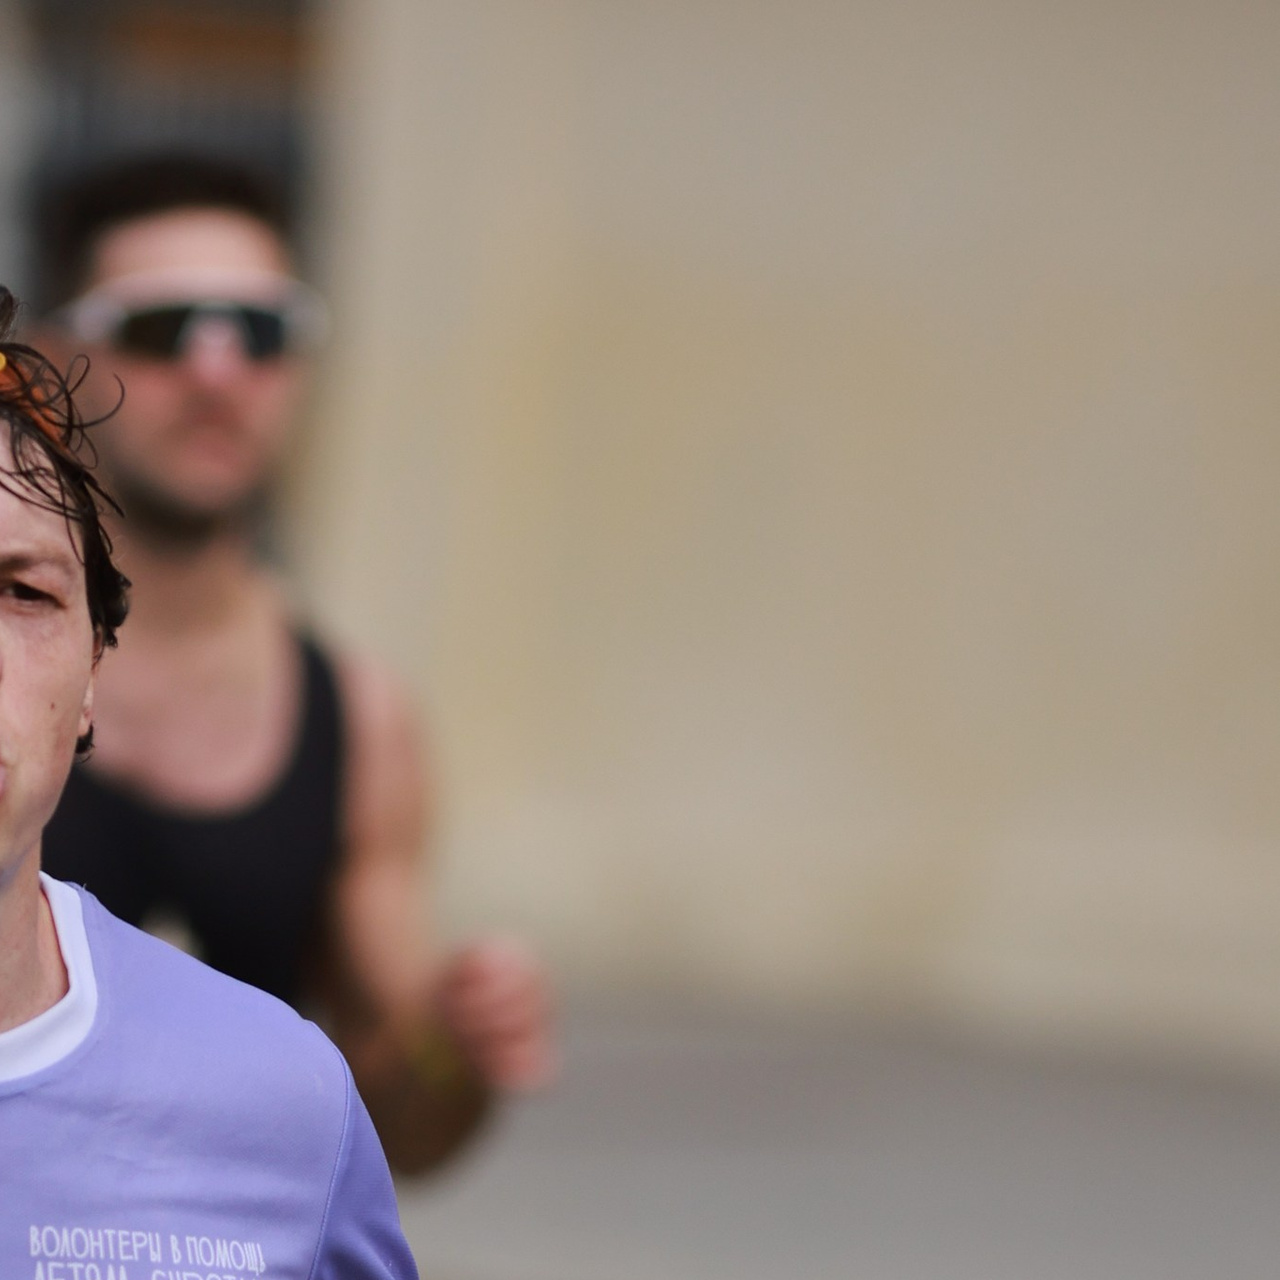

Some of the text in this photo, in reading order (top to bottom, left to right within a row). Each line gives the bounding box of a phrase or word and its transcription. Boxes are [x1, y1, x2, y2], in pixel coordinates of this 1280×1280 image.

[29, 1225, 267, 1275] ВОЛОНТЕРЫ В ПОМОЩЬ
